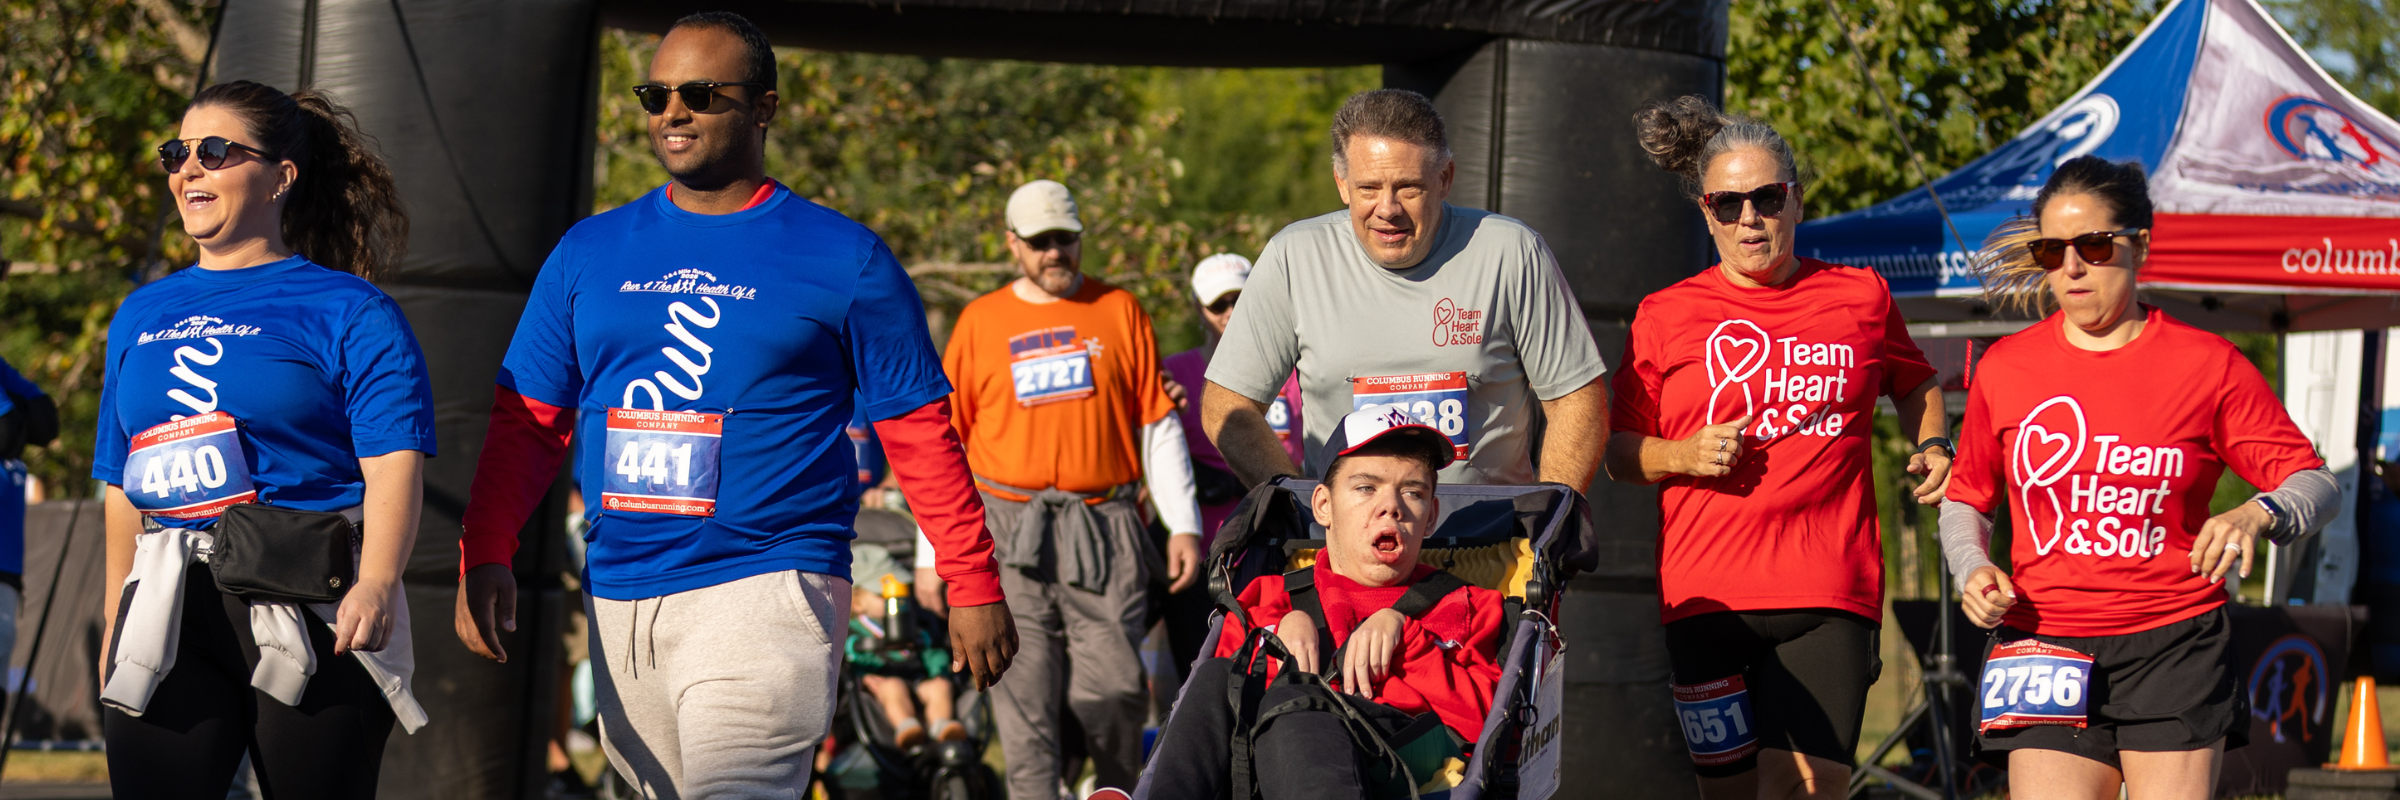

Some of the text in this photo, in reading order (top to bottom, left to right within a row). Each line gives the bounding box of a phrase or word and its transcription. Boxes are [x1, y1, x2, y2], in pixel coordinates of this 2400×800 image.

[619, 280, 641, 291] Run
[643, 281, 653, 291] 4
[652, 281, 672, 291] The
[695, 283, 730, 295] Health
[731, 285, 747, 300] Of
[1457, 308, 1482, 320] Team
[137, 331, 155, 344] Run
[201, 323, 235, 337] Health
[234, 324, 252, 337] Of
[1451, 320, 1479, 332] Heart
[1450, 332, 1482, 345] &Sole
[1776, 336, 1854, 369] Team
[1014, 356, 1087, 394] 2727
[1366, 373, 1451, 385] COLUMBUS RUNNING
[1389, 383, 1429, 391] COMPANY
[1763, 367, 1848, 404] Heart
[140, 413, 218, 440] COLUMBUS RUNNING
[617, 410, 705, 423] COLUMBUS RUNNING
[636, 421, 678, 430] COMPANY
[1755, 403, 1843, 441] &Sole
[157, 427, 195, 441] COMPANY
[616, 440, 692, 486] 441
[2093, 435, 2184, 477] Team
[141, 445, 227, 499] 440
[2070, 474, 2171, 516] Heart
[620, 500, 705, 512] columbusrunning.com
[2064, 516, 2167, 558] &Sole
[2016, 646, 2053, 655] COMPANY
[1679, 692, 1709, 700] COMPANY
[1694, 679, 1729, 693] RUNNING
[1984, 665, 2083, 709] 2756
